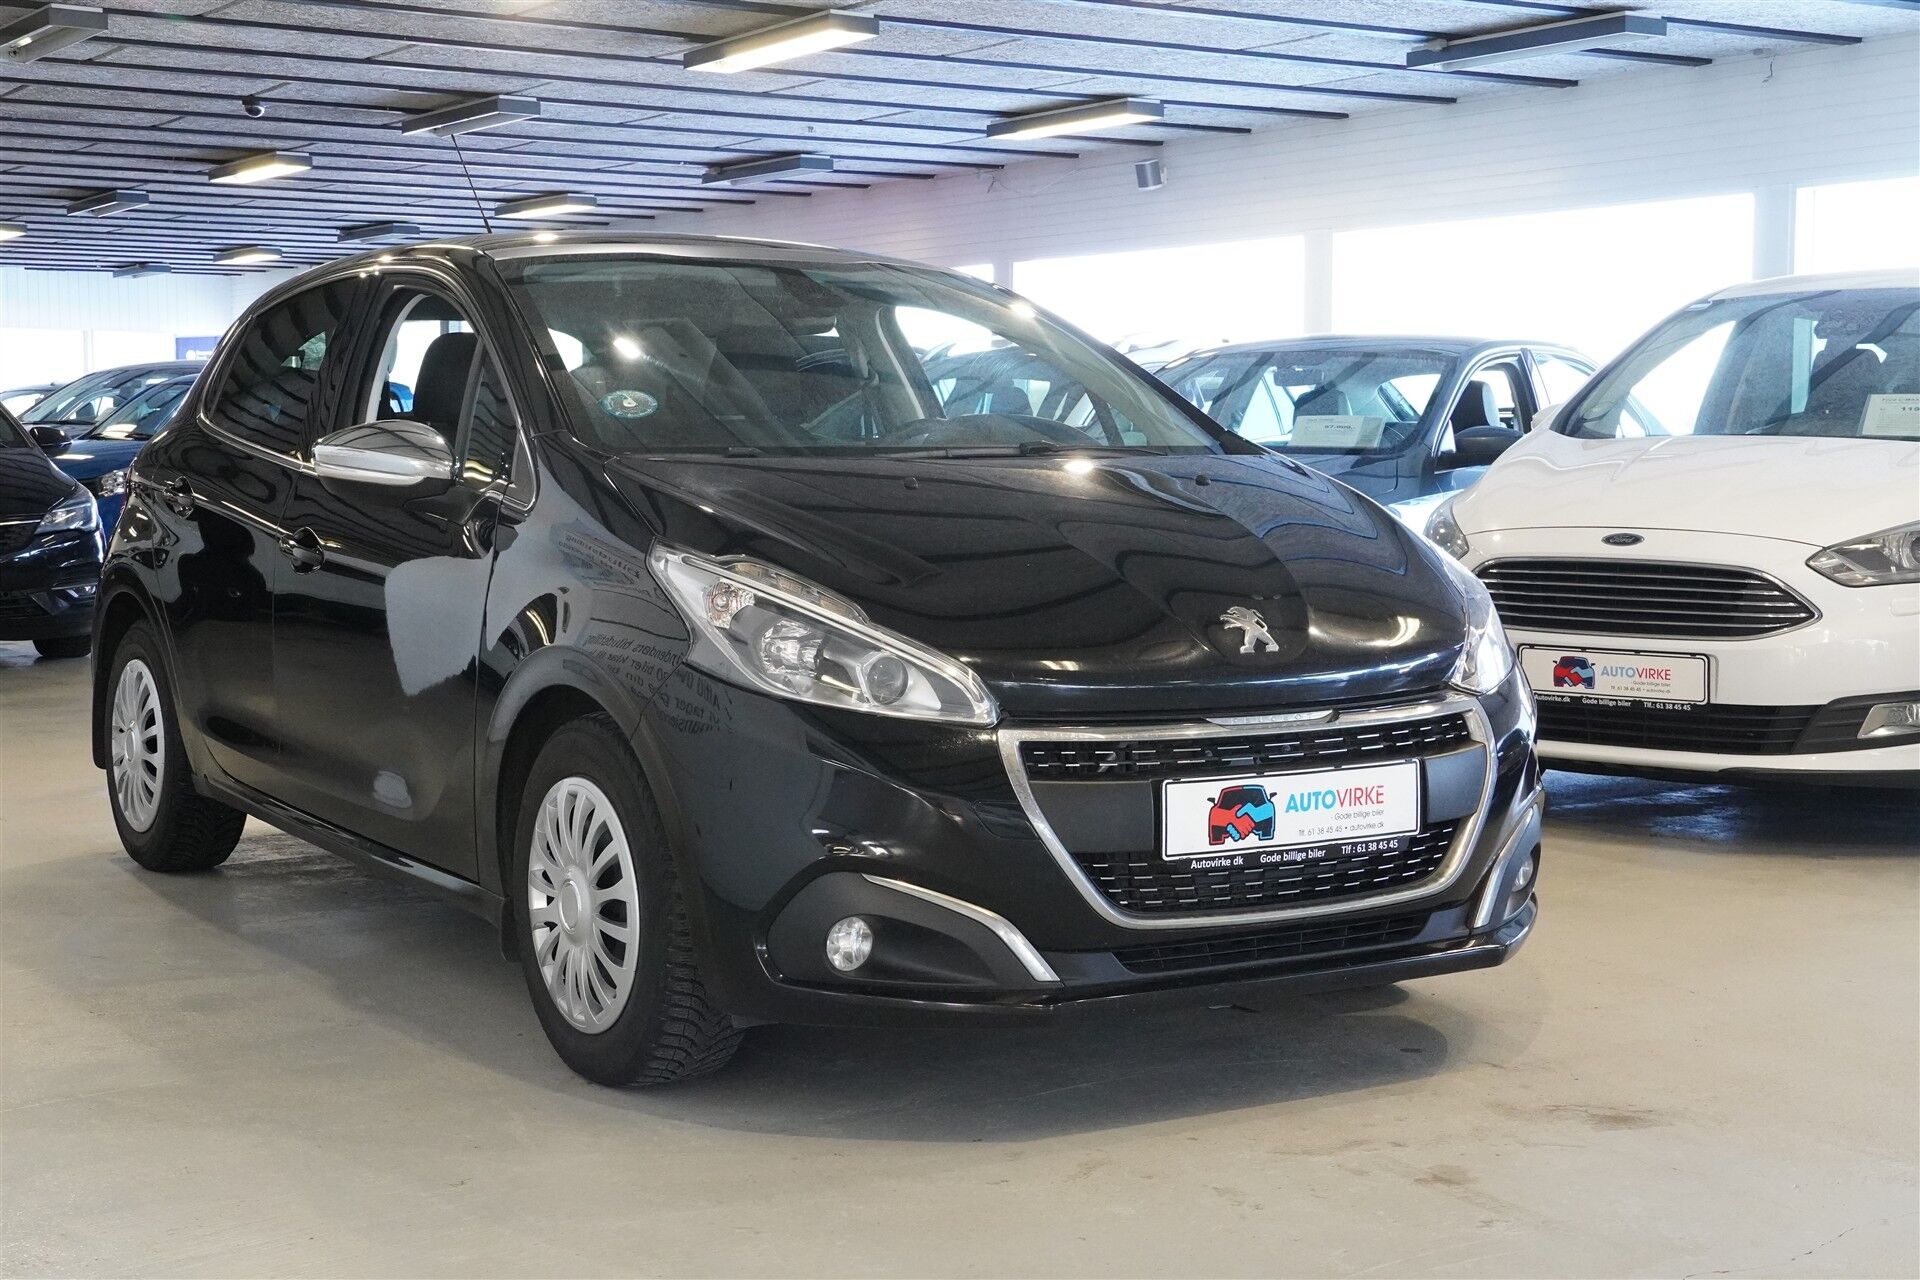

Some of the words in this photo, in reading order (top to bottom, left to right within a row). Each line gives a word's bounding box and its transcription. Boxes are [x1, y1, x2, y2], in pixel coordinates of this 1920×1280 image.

[1601, 665, 1671, 681] AUTOVIRKE
[1582, 697, 1598, 705] Gode
[1598, 698, 1616, 707] billige
[1617, 699, 1632, 707] biler
[1286, 785, 1384, 813] AUTOVIRKE
[1334, 812, 1352, 821] Gode
[1353, 810, 1371, 819] billige
[1372, 809, 1385, 817] biler
[1307, 828, 1315, 836] 61
[1317, 827, 1325, 835] 38
[1325, 826, 1334, 834] 45
[1334, 825, 1343, 833] 45
[1349, 821, 1385, 832] autovirke.dk
[1191, 858, 1231, 869] Autovirke
[1233, 857, 1244, 865] dk
[1260, 854, 1281, 863] Gode
[1283, 851, 1307, 862] billige
[1308, 849, 1326, 858] biler
[1357, 843, 1366, 852] 61
[1368, 842, 1377, 851] 38
[1378, 841, 1388, 849] 45
[1389, 840, 1398, 848] 45
